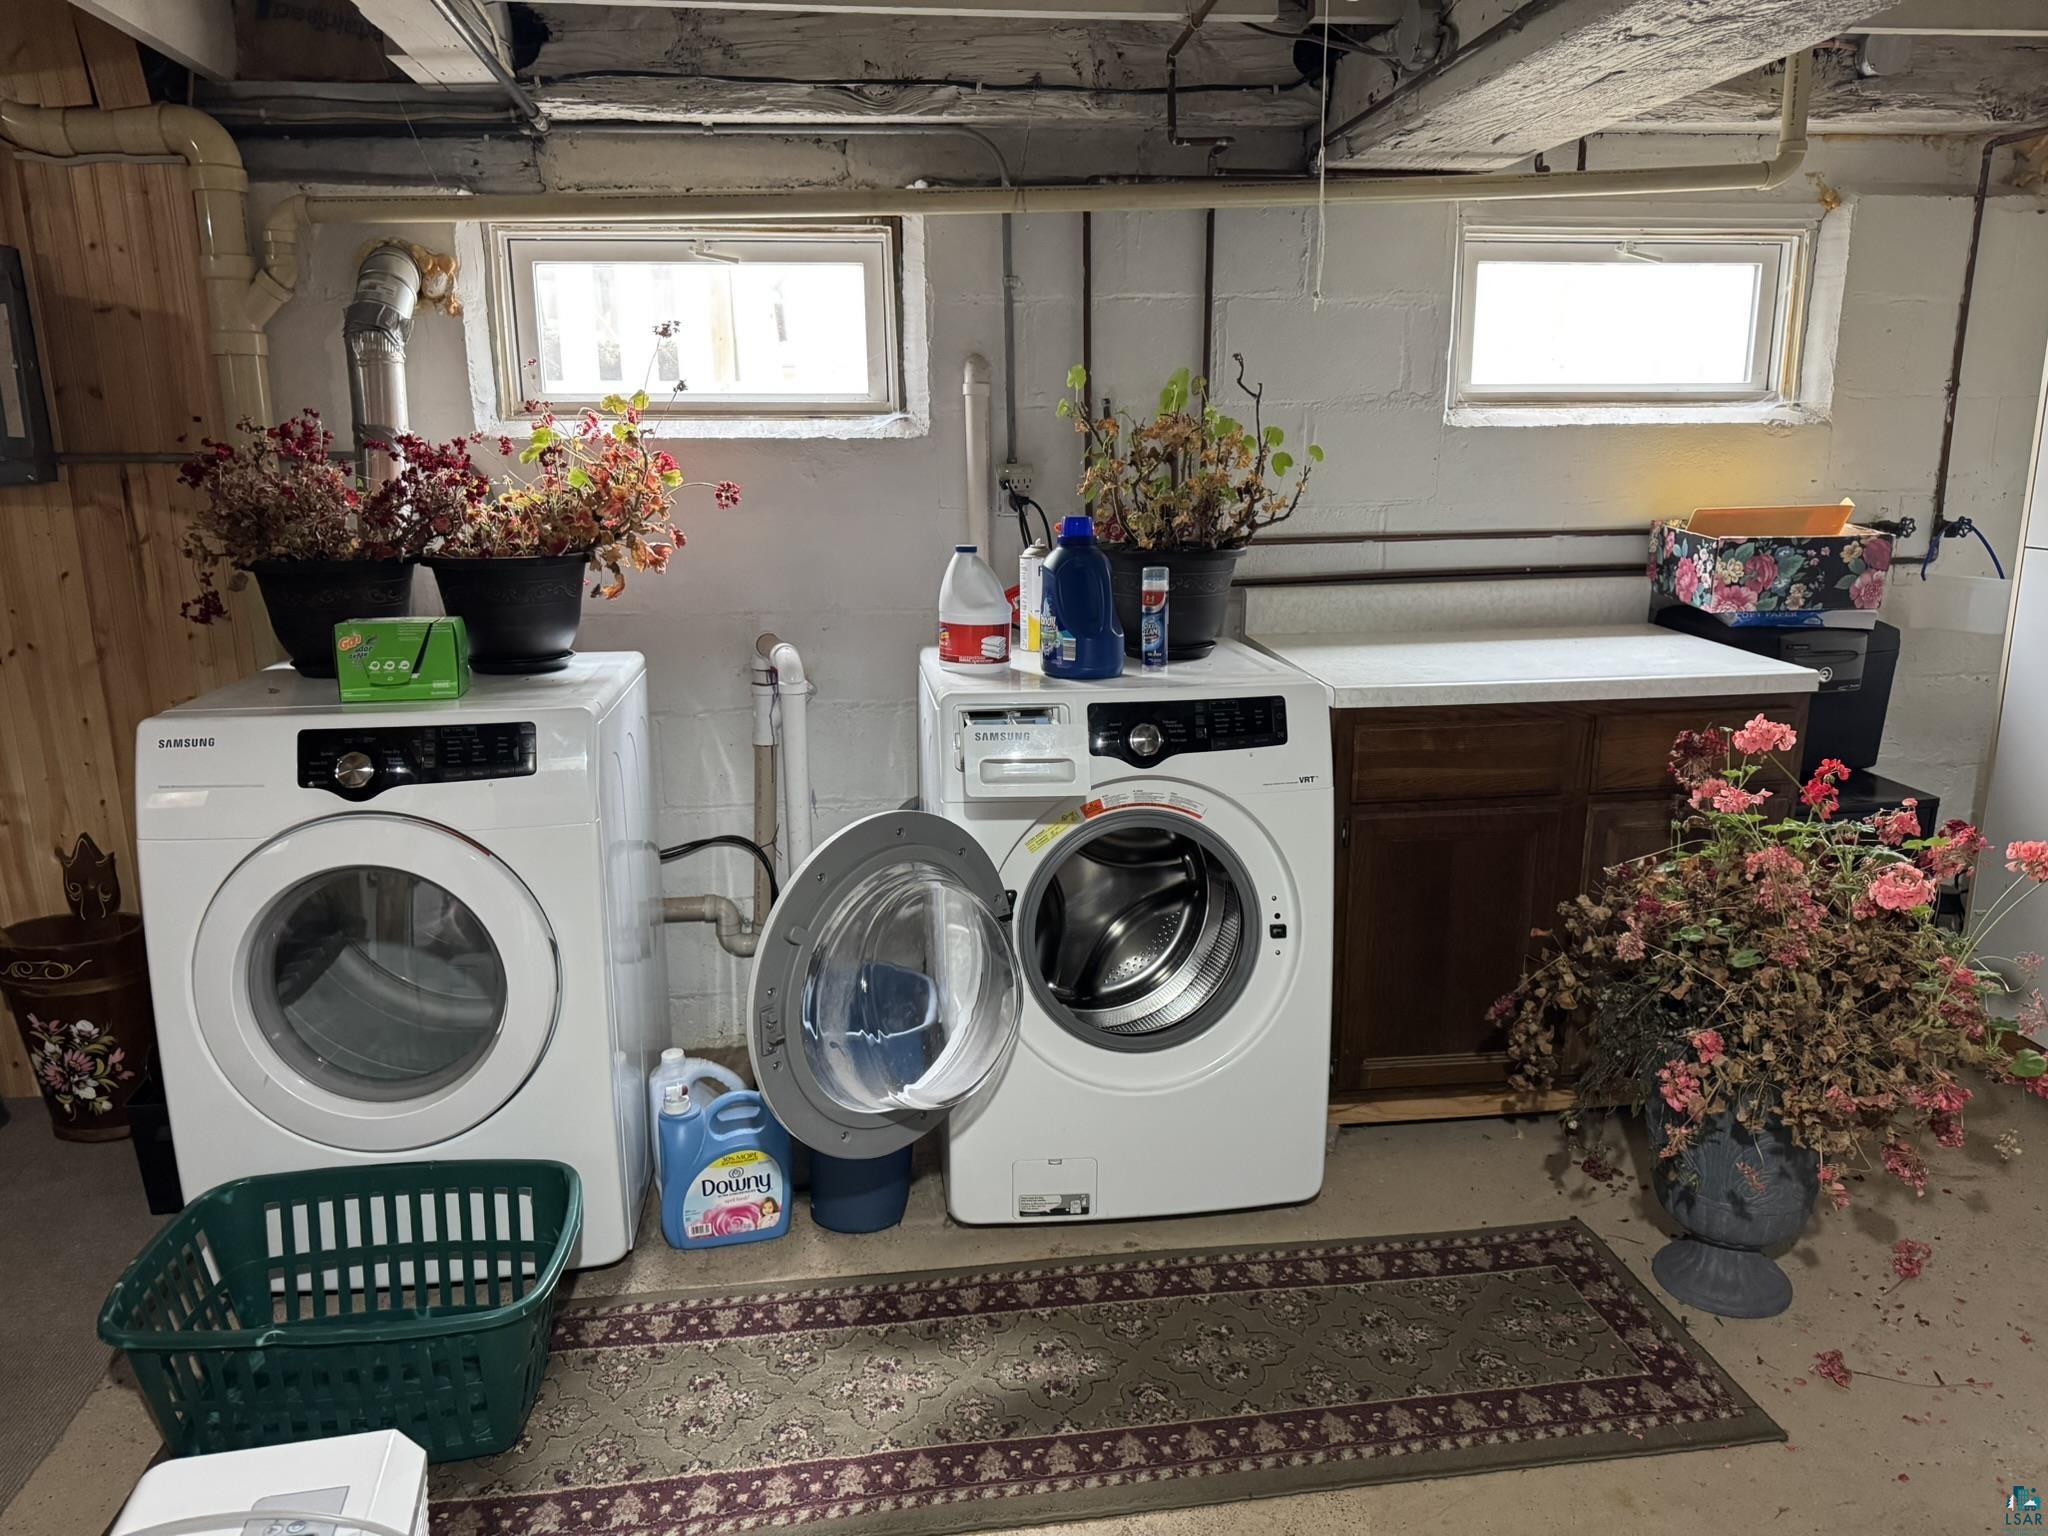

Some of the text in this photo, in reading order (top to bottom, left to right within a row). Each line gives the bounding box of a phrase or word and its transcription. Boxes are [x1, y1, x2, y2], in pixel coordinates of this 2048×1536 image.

[974, 731, 1030, 742] SAMSUNG
[158, 737, 215, 749] SAMSUNG
[702, 1173, 771, 1196] Downy
